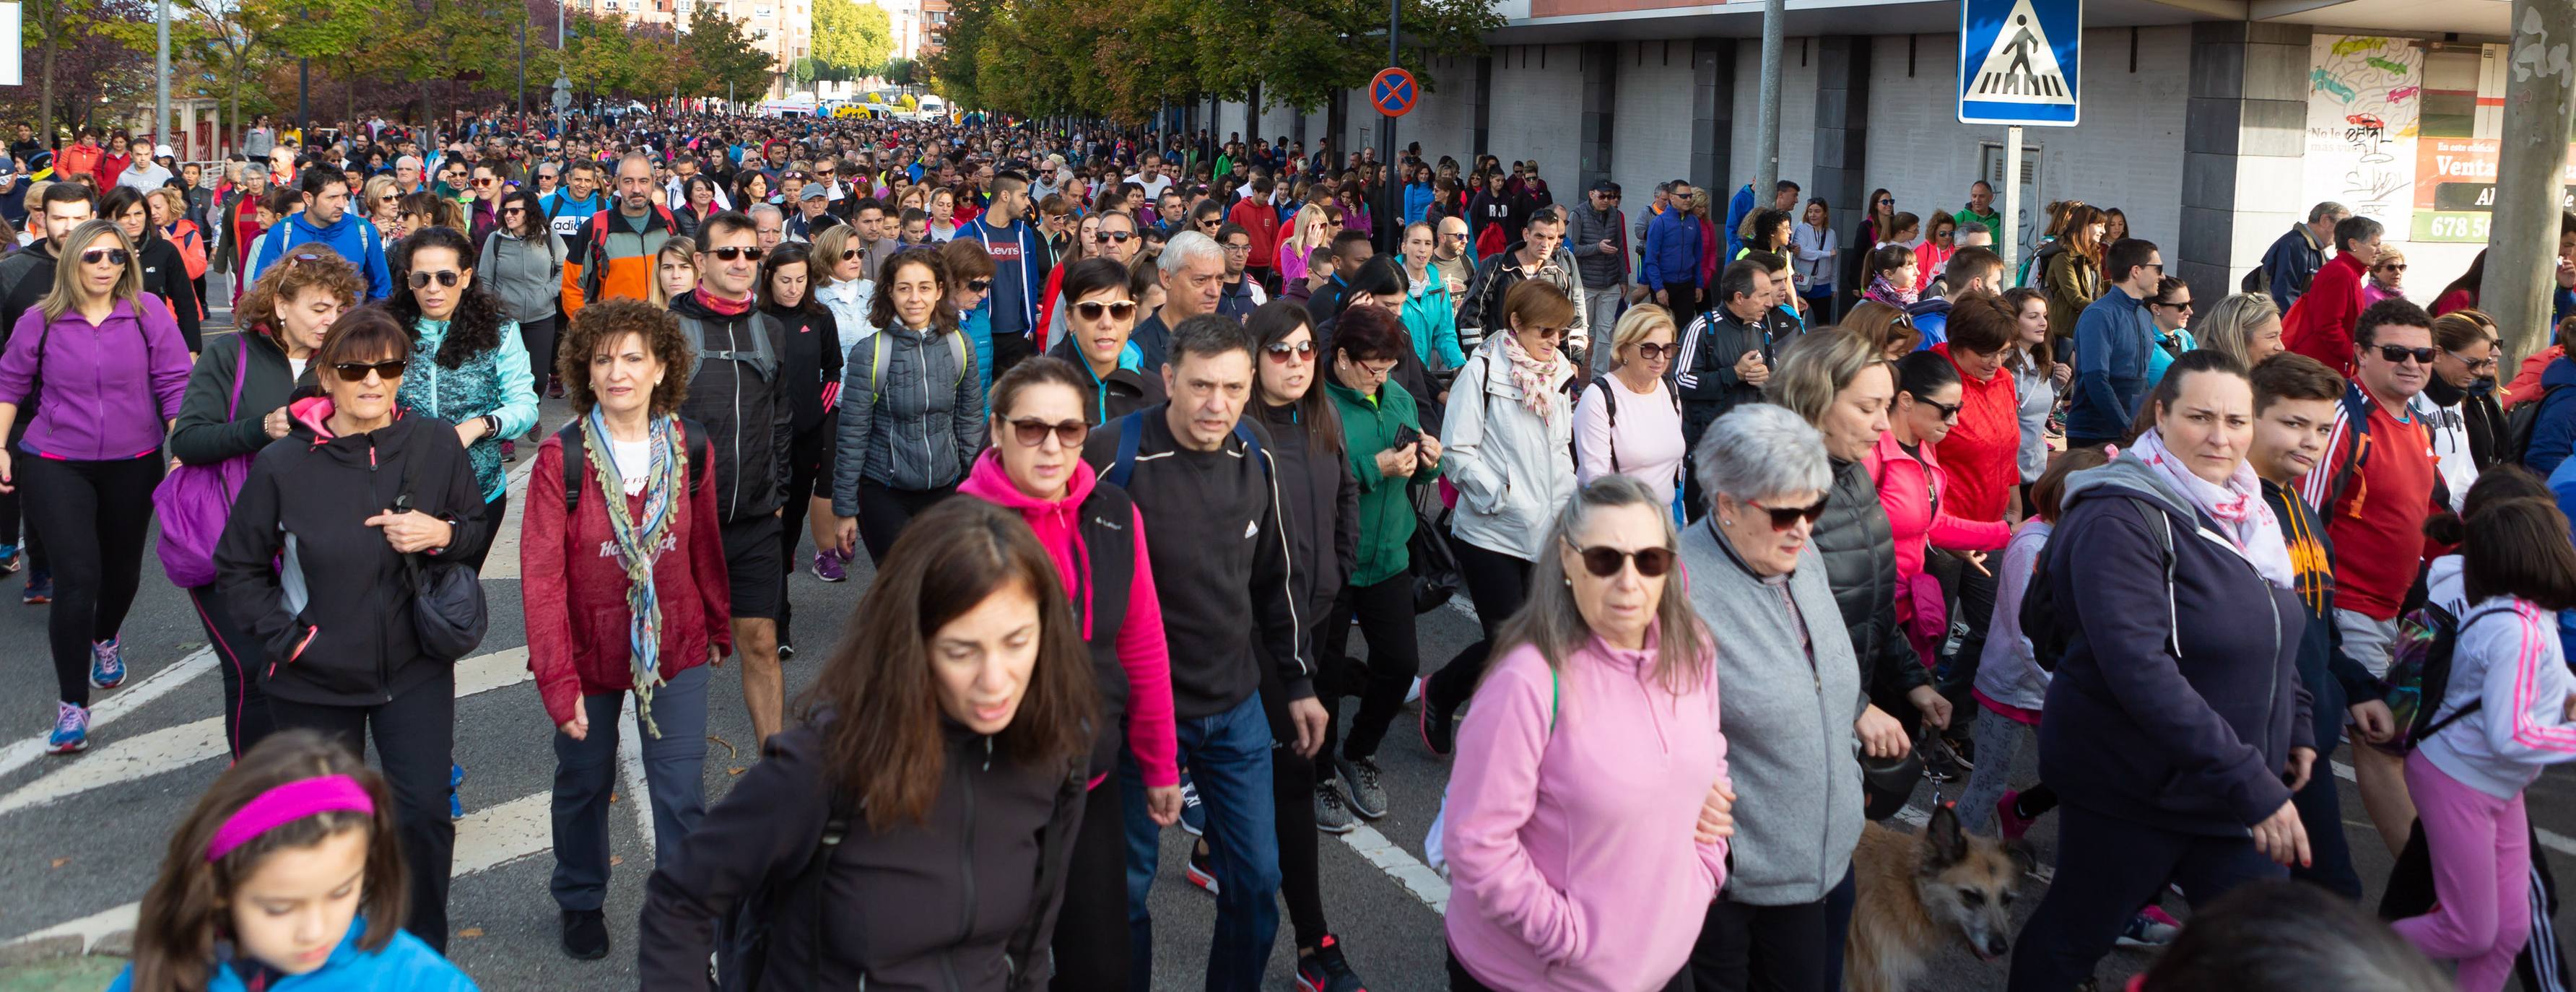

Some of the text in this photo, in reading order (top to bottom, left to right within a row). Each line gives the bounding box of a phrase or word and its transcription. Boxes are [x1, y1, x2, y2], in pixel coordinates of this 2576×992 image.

[2311, 127, 2341, 138] No le
[2436, 155, 2497, 177] Venta
[2431, 216, 2468, 238] 678
